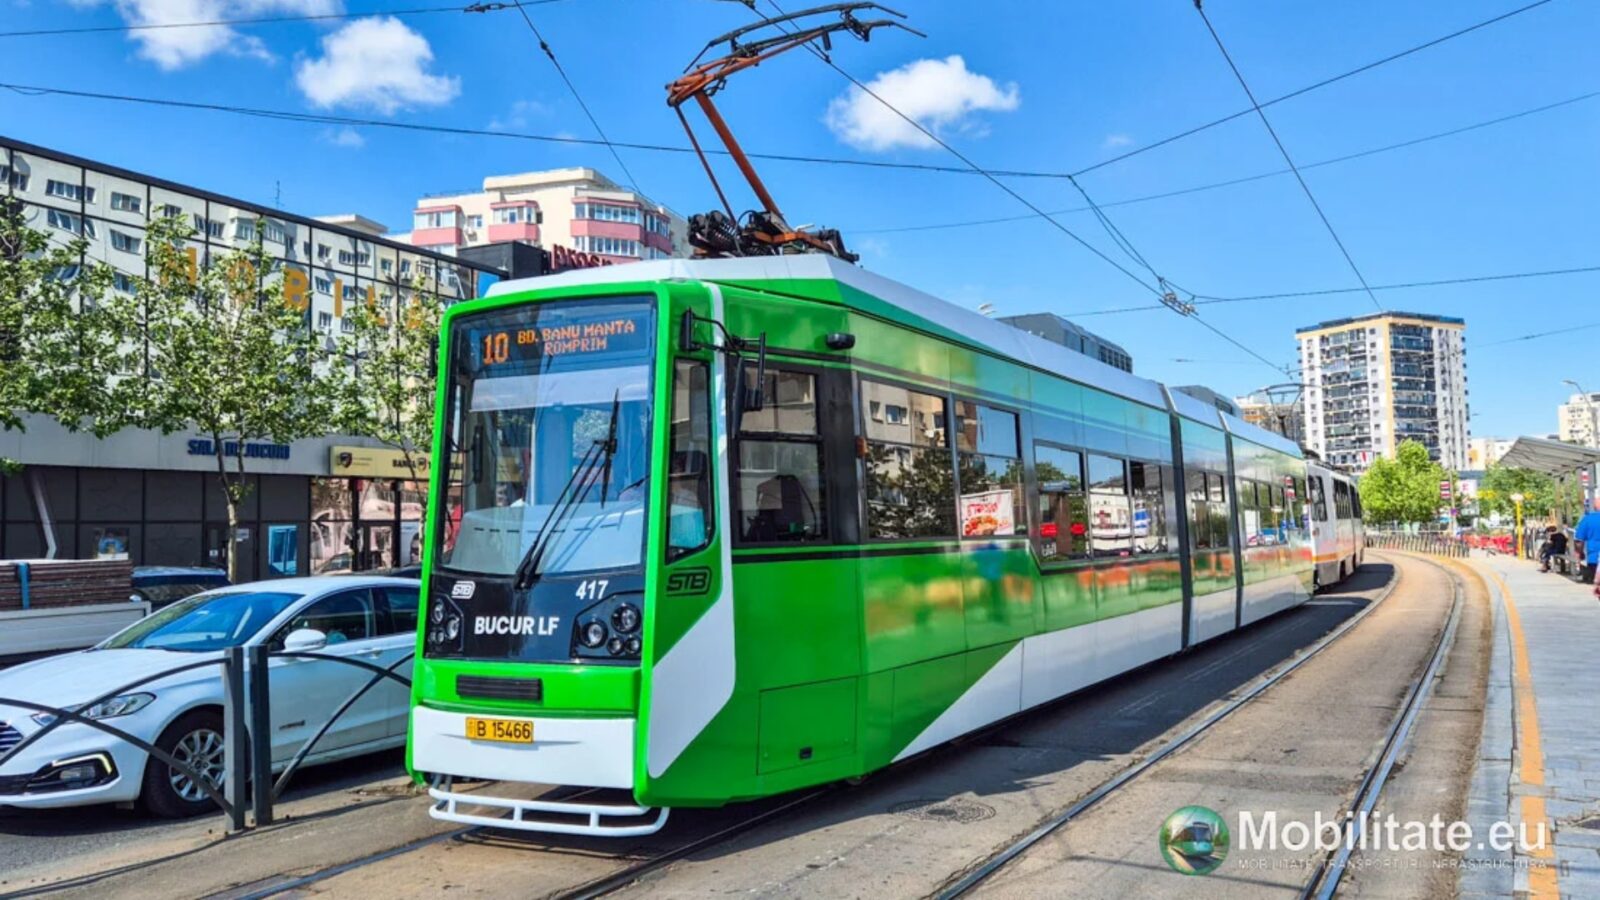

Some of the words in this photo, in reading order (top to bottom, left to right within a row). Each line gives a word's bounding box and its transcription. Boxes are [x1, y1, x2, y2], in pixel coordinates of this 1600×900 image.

[517, 329, 539, 345] BD.
[542, 323, 581, 341] BANU
[583, 319, 635, 338] MANTA
[483, 332, 510, 365] 10
[544, 337, 608, 356] ROMPRIM
[451, 581, 476, 599] STB
[575, 579, 609, 601] 417
[665, 567, 711, 596] STB
[474, 615, 534, 635] BUCUR
[537, 616, 560, 636] LF
[476, 720, 487, 738] B
[492, 721, 531, 740] 15466
